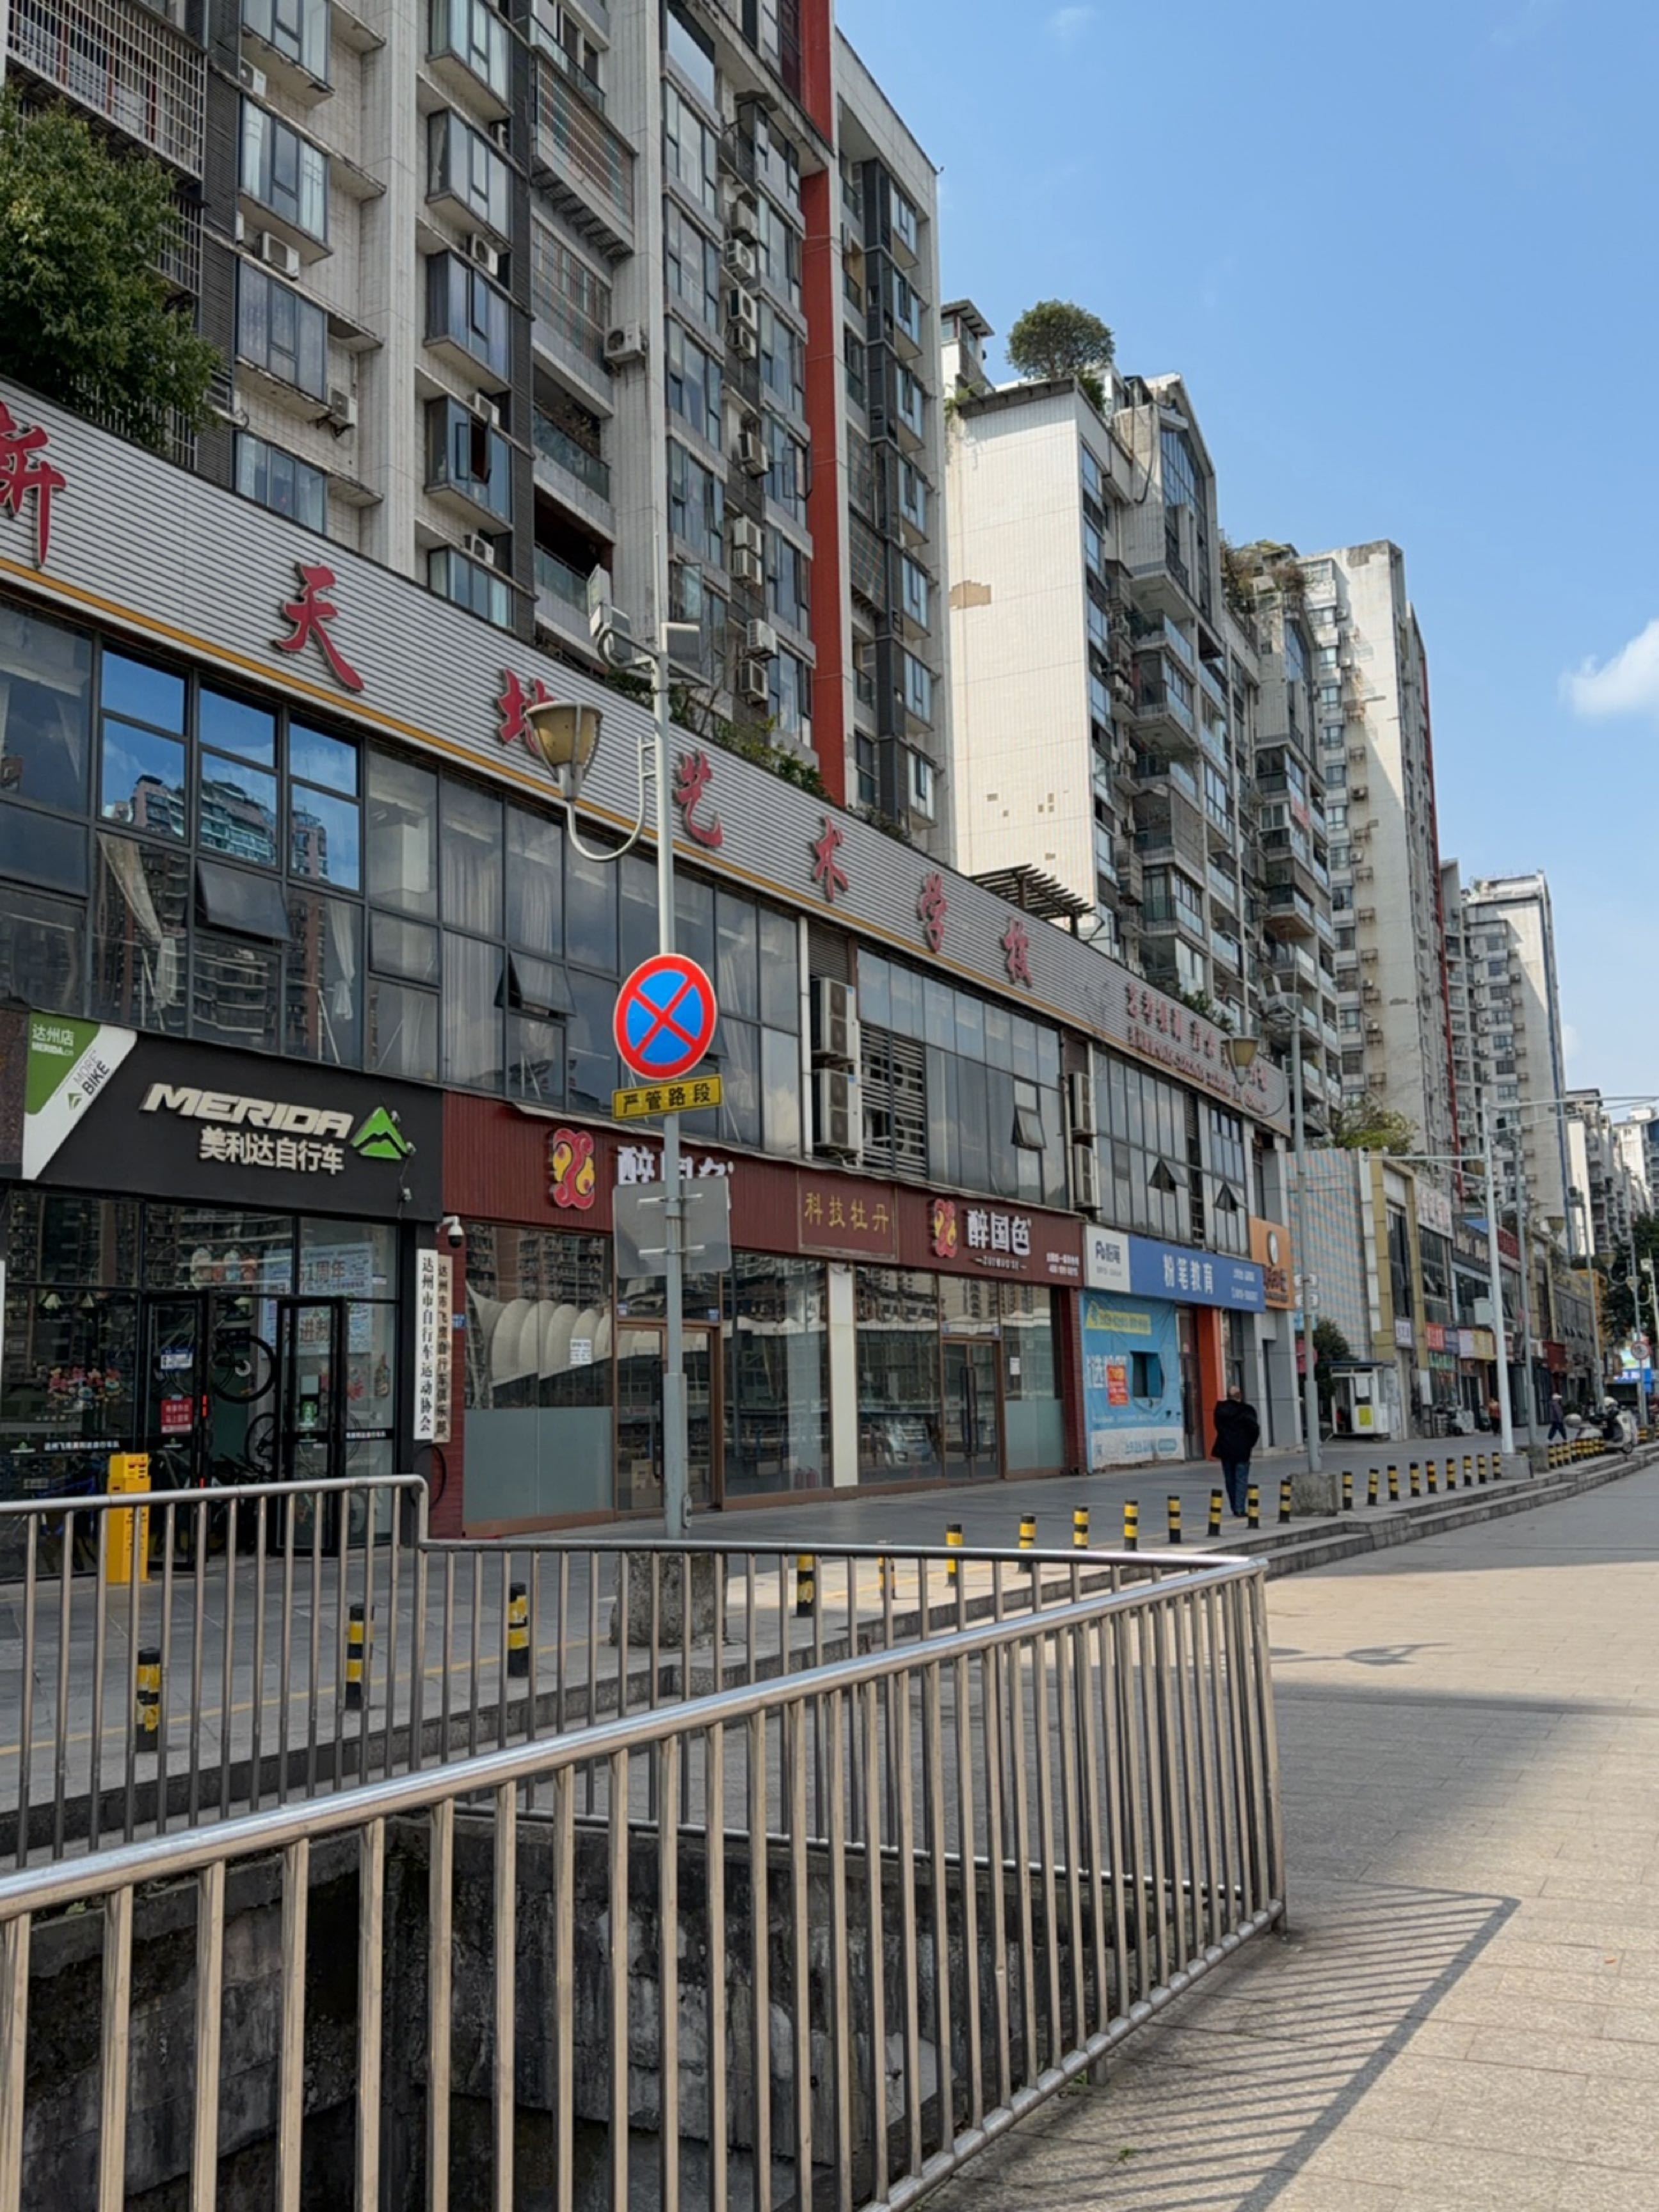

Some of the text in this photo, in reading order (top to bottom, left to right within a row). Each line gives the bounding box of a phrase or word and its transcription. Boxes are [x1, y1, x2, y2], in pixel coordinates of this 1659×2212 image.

[32, 1024, 74, 1046] 达州店
[72, 1050, 98, 1084] MORE
[81, 1060, 110, 1096] BIKE
[139, 1082, 354, 1139] MERIDA
[623, 1082, 710, 1114] 严管路段
[198, 1125, 345, 1175] 美利达自行车
[804, 1192, 890, 1235] 科技牡丹
[967, 1208, 1032, 1256] 醉国色
[1163, 1254, 1214, 1295] 粉笔教育
